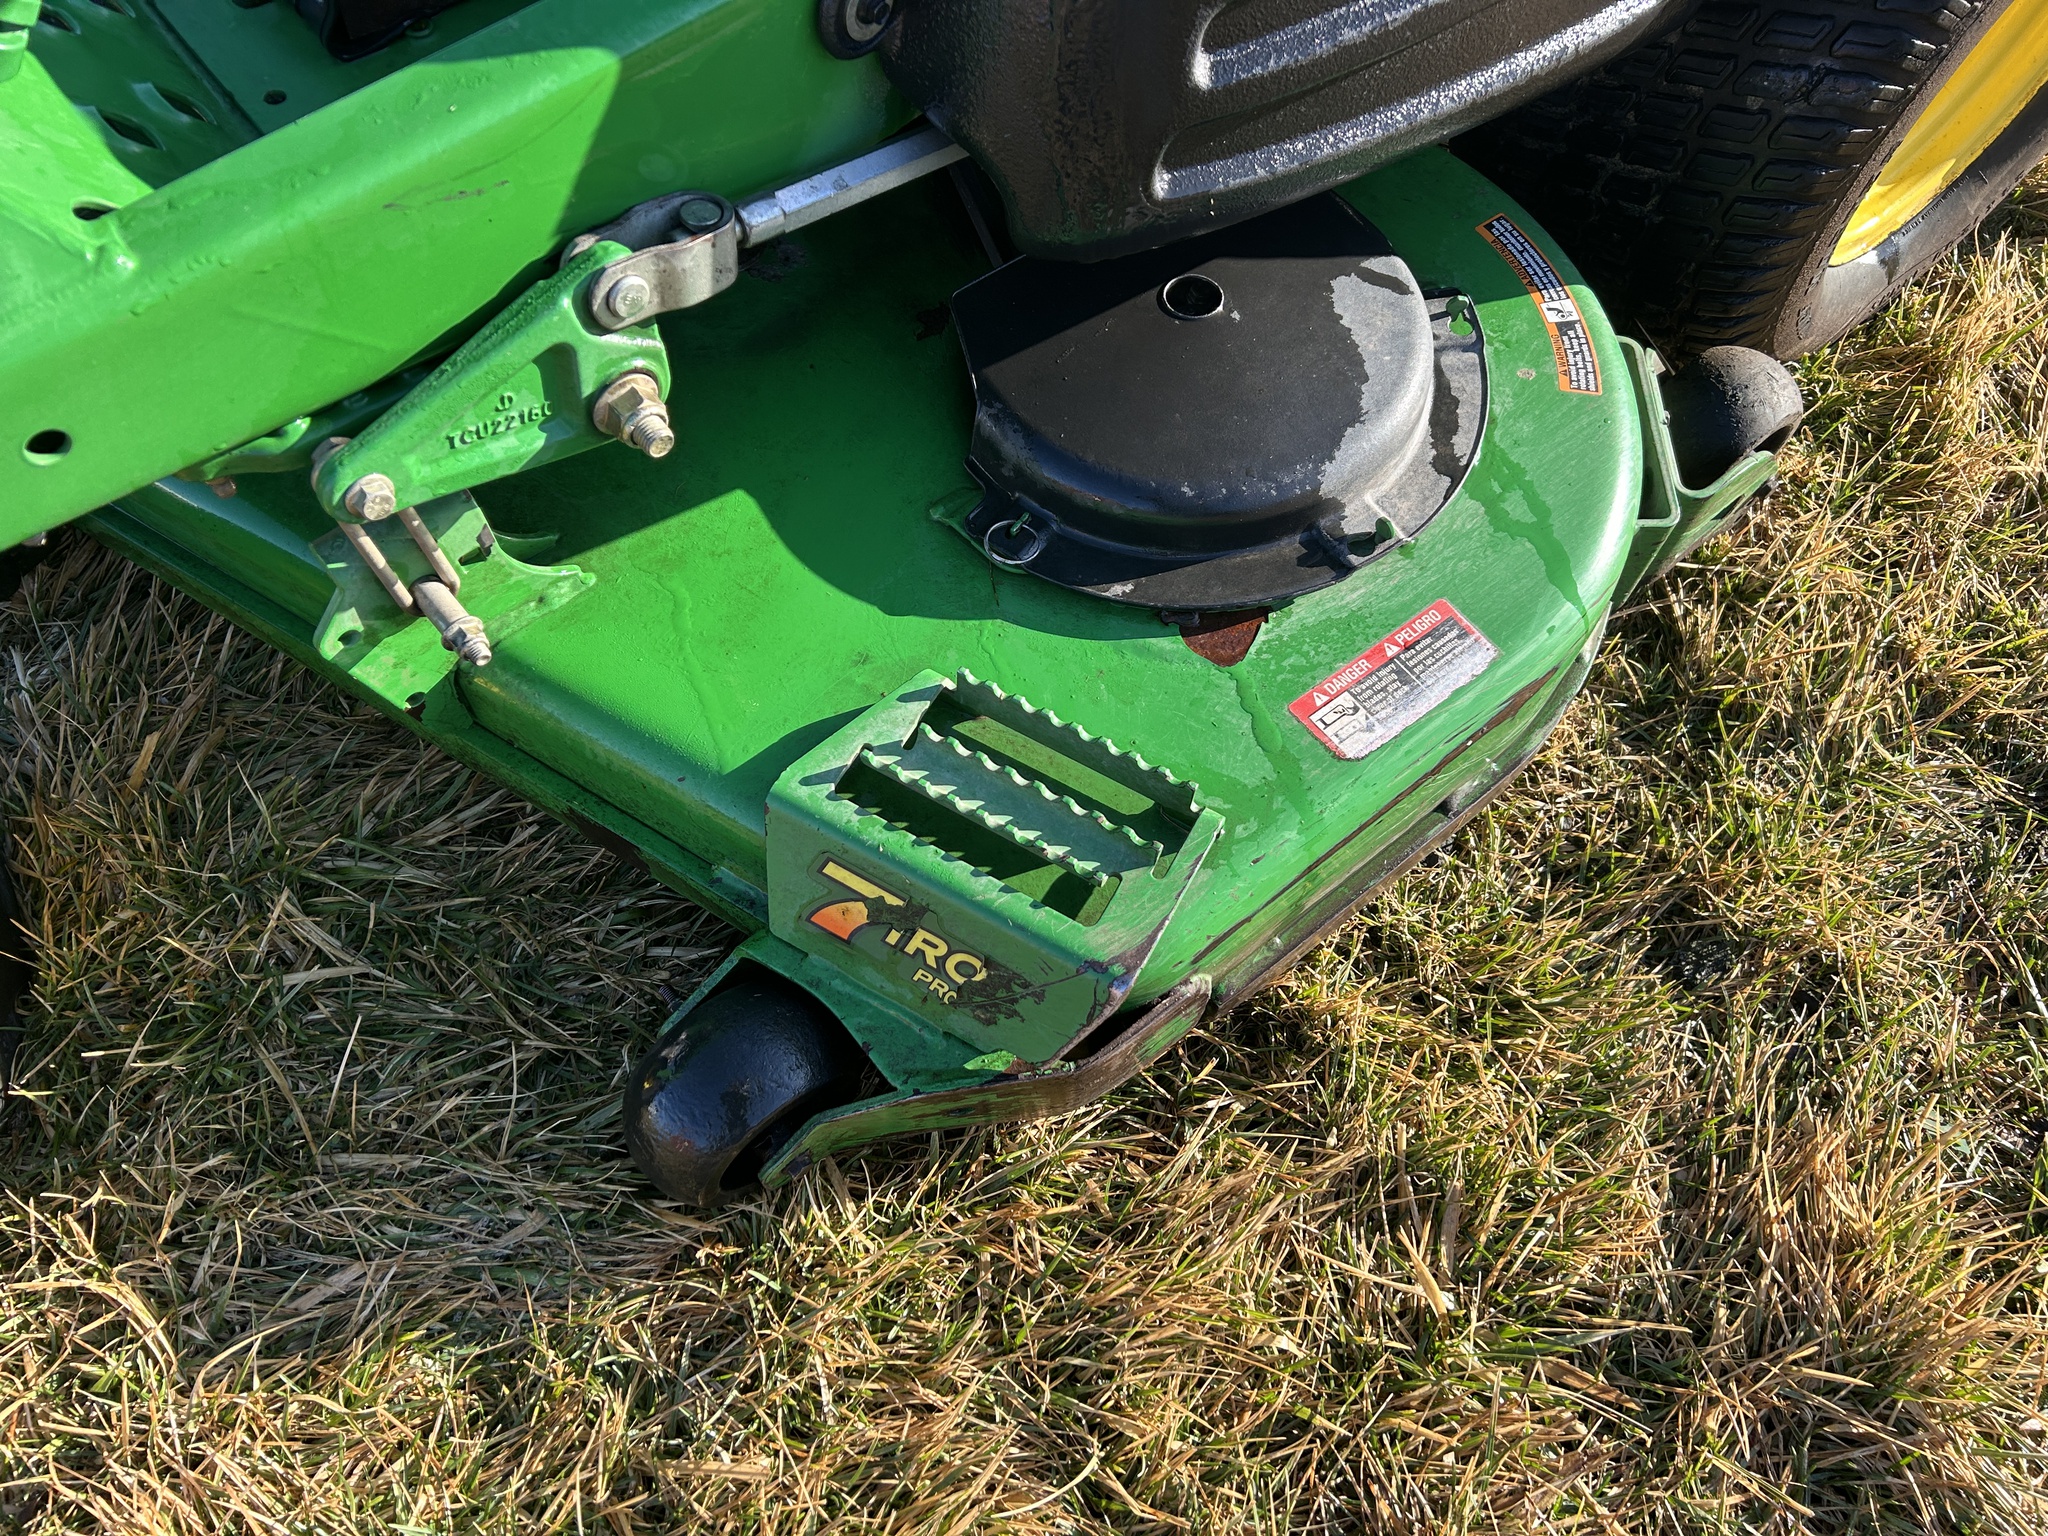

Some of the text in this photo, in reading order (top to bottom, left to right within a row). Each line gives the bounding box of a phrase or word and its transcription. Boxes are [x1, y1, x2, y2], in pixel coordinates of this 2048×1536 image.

[1490, 238, 1529, 281] ADVERTENCIA
[1551, 334, 1566, 368] WARNING
[1562, 336, 1571, 348] from
[1583, 344, 1592, 361] guards
[1566, 350, 1575, 365] injury
[1585, 362, 1593, 372] and
[1569, 366, 1577, 380] avoid
[1578, 369, 1586, 389] rotating
[1394, 608, 1442, 646] PELIGRO
[1399, 636, 1433, 661] Para evitar
[1406, 647, 1433, 667] lesiones
[1413, 663, 1425, 674] por
[1423, 656, 1435, 666] las
[1323, 658, 1373, 695] DANGER
[1350, 663, 1396, 695] To avoid injury
[1356, 673, 1398, 702] from rotating
[1363, 690, 1388, 708] blades,
[1386, 680, 1402, 692] stay
